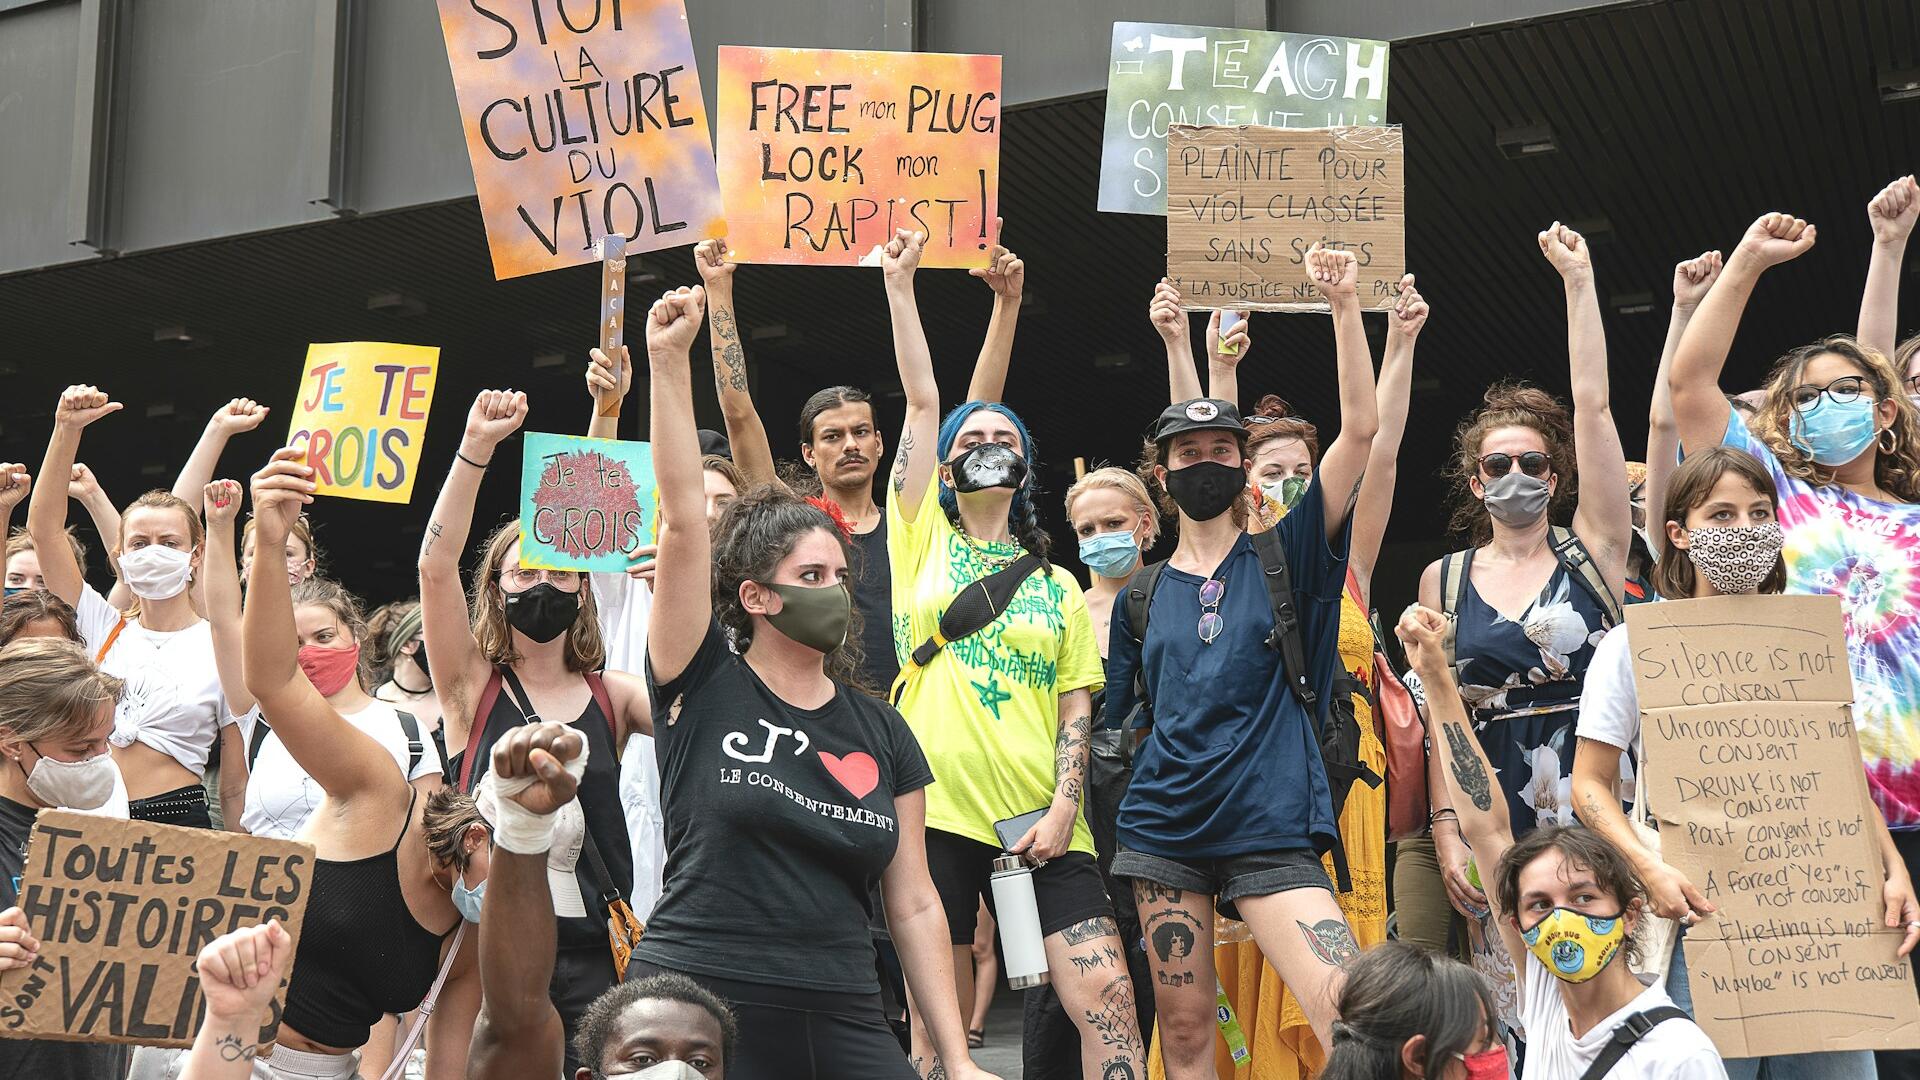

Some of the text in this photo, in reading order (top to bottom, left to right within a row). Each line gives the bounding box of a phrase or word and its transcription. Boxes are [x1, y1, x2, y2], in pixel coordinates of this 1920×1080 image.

[554, 46, 604, 82] LA
[1149, 34, 1387, 100] TEACH
[480, 65, 694, 160] CULTURE
[749, 79, 996, 134] FREE mon PLUG
[568, 147, 616, 183] DU
[762, 143, 938, 184] LOCK mon
[1318, 146, 1387, 181] POUR
[517, 177, 688, 255] VIOL
[1267, 187, 1386, 222] CLASSÉE
[1204, 237, 1272, 263] SANS
[1192, 280, 1211, 296] LA
[304, 361, 432, 420] JE TE
[532, 507, 642, 554] CROIS
[1638, 642, 1836, 679] Silence is not
[1657, 714, 1799, 741] Unconscious
[1801, 714, 1820, 740] is
[720, 768, 894, 832] LE CONSENTEMENT
[1675, 773, 1763, 802] DRUNK
[1791, 771, 1822, 793] NOT
[1688, 821, 1735, 846] Past
[1818, 817, 1832, 837] is
[1838, 815, 1863, 836] not
[217, 850, 305, 905] LES
[1705, 870, 1719, 899] A
[1727, 866, 1787, 894] forced
[1755, 886, 1796, 907] not
[22, 885, 289, 957] HiSTOiR
[1816, 918, 1835, 936] is
[1844, 918, 1875, 937] not
[1792, 972, 1808, 989] is
[1818, 962, 1849, 986] not
